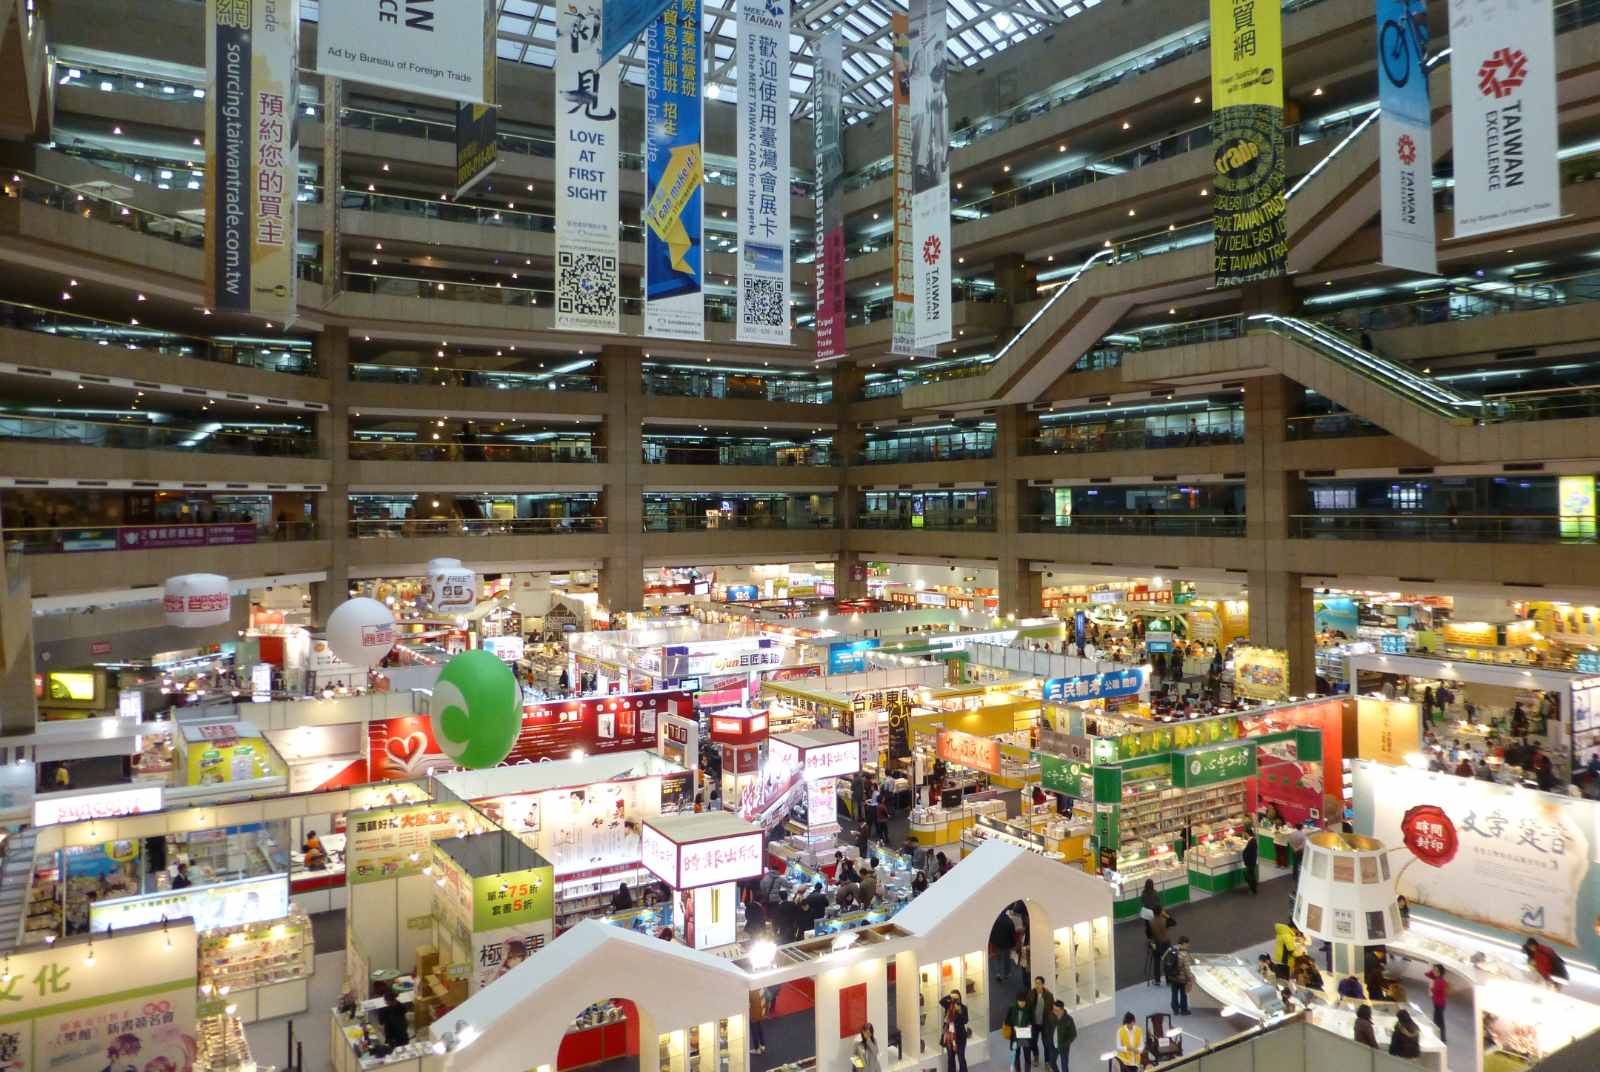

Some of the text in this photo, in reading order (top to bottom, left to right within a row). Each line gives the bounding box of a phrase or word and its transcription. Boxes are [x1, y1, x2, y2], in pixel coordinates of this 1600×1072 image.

[744, 14, 783, 29] TAIWAN
[344, 51, 357, 62] by
[359, 53, 395, 68] Bureau
[397, 60, 406, 70] of
[409, 62, 444, 78] Foreign
[447, 70, 472, 83] Trade
[648, 56, 660, 102] Trade
[748, 72, 756, 98] MEET
[569, 129, 605, 146] LOVE
[748, 102, 757, 140] TAIWAN
[759, 35, 777, 238] 歡迎使用臺灣會展卡
[579, 150, 596, 163] AT
[748, 143, 757, 170] CARD
[1485, 110, 1501, 191] EXCELLENCE
[1502, 100, 1524, 188] TAIWAN
[222, 43, 244, 294] sourcing.taiwantrade.com.tw
[257, 92, 285, 247] 預約您的買主
[568, 168, 606, 183] FIRST
[567, 184, 608, 202] SIGHT
[815, 150, 824, 257] EXHIBITION
[1406, 171, 1416, 224] TAIWAN
[1230, 251, 1268, 271] TAIWAN
[816, 263, 824, 311] HALL
[931, 267, 940, 320] TAIWAN
